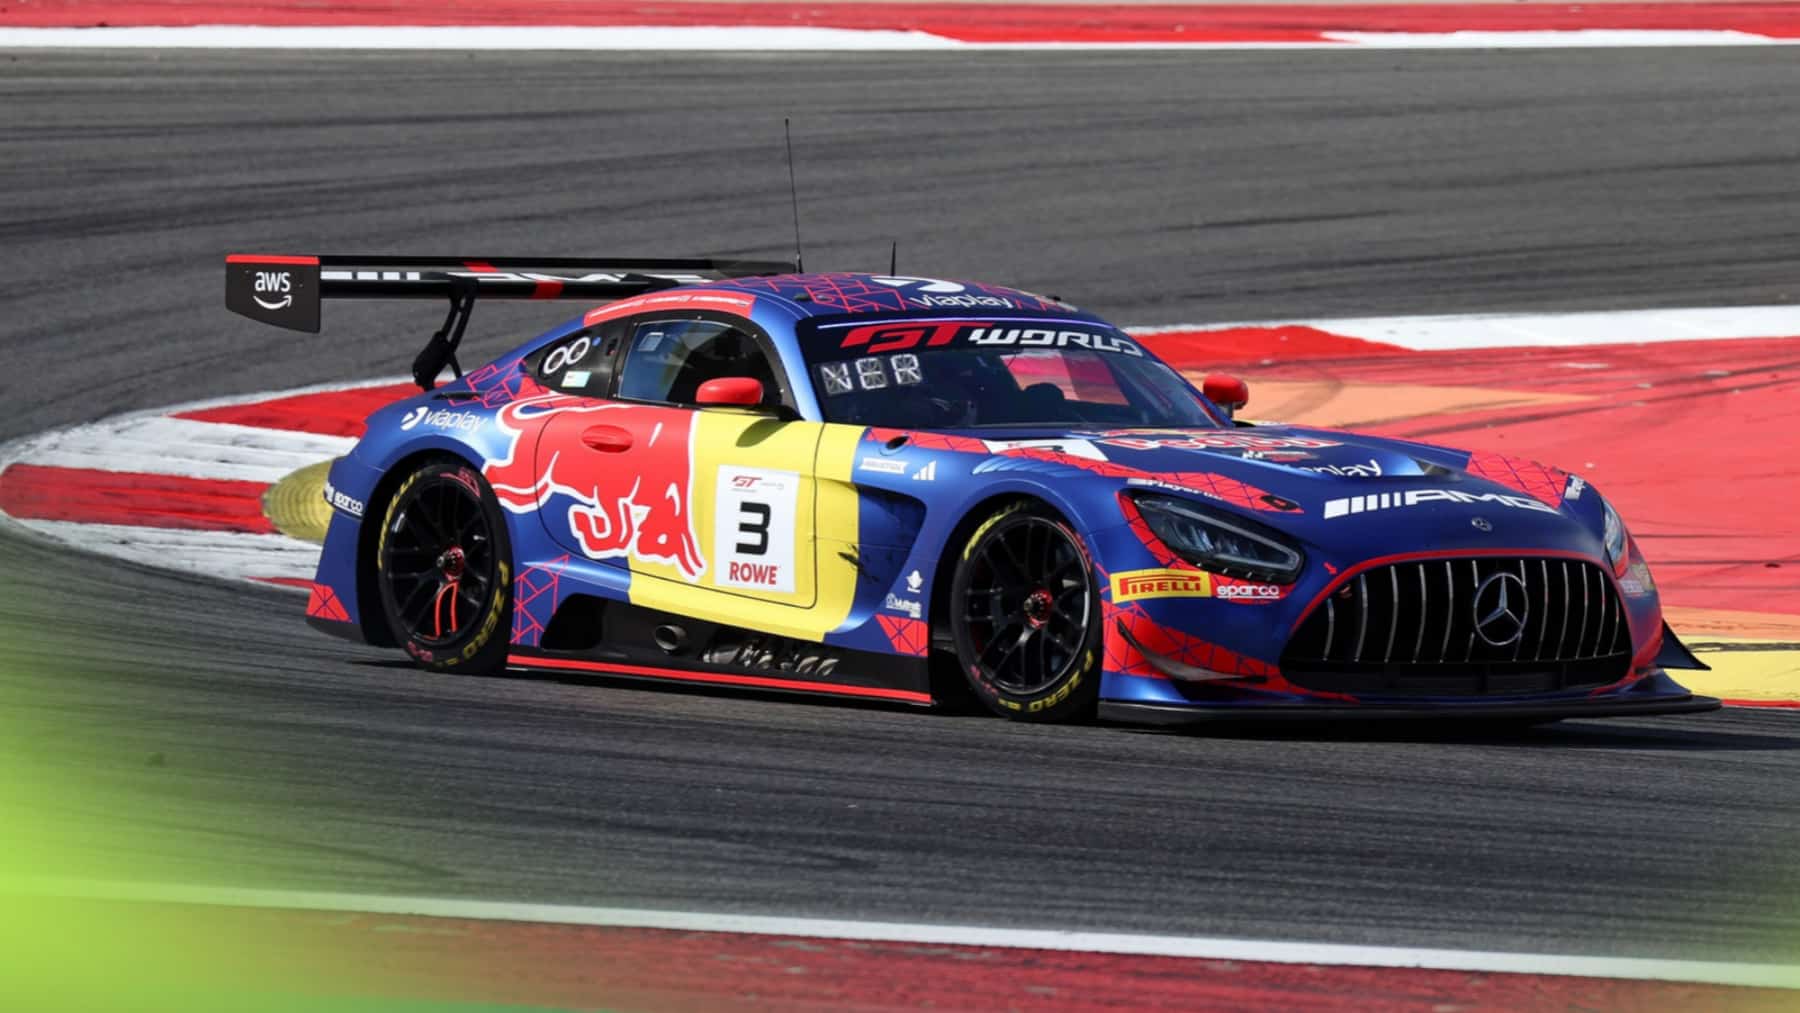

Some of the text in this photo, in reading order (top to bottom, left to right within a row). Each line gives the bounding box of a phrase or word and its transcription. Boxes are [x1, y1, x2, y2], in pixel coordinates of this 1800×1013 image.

[254, 271, 291, 292] aws
[909, 294, 1014, 309] viaplay
[840, 321, 1145, 358] GT WORLD
[423, 408, 488, 432] viaplay
[1404, 489, 1563, 516] AMG
[735, 501, 771, 555] 3
[729, 561, 777, 585] ROWE
[1119, 574, 1202, 596] PIRELLI
[1216, 584, 1280, 599] sparco
